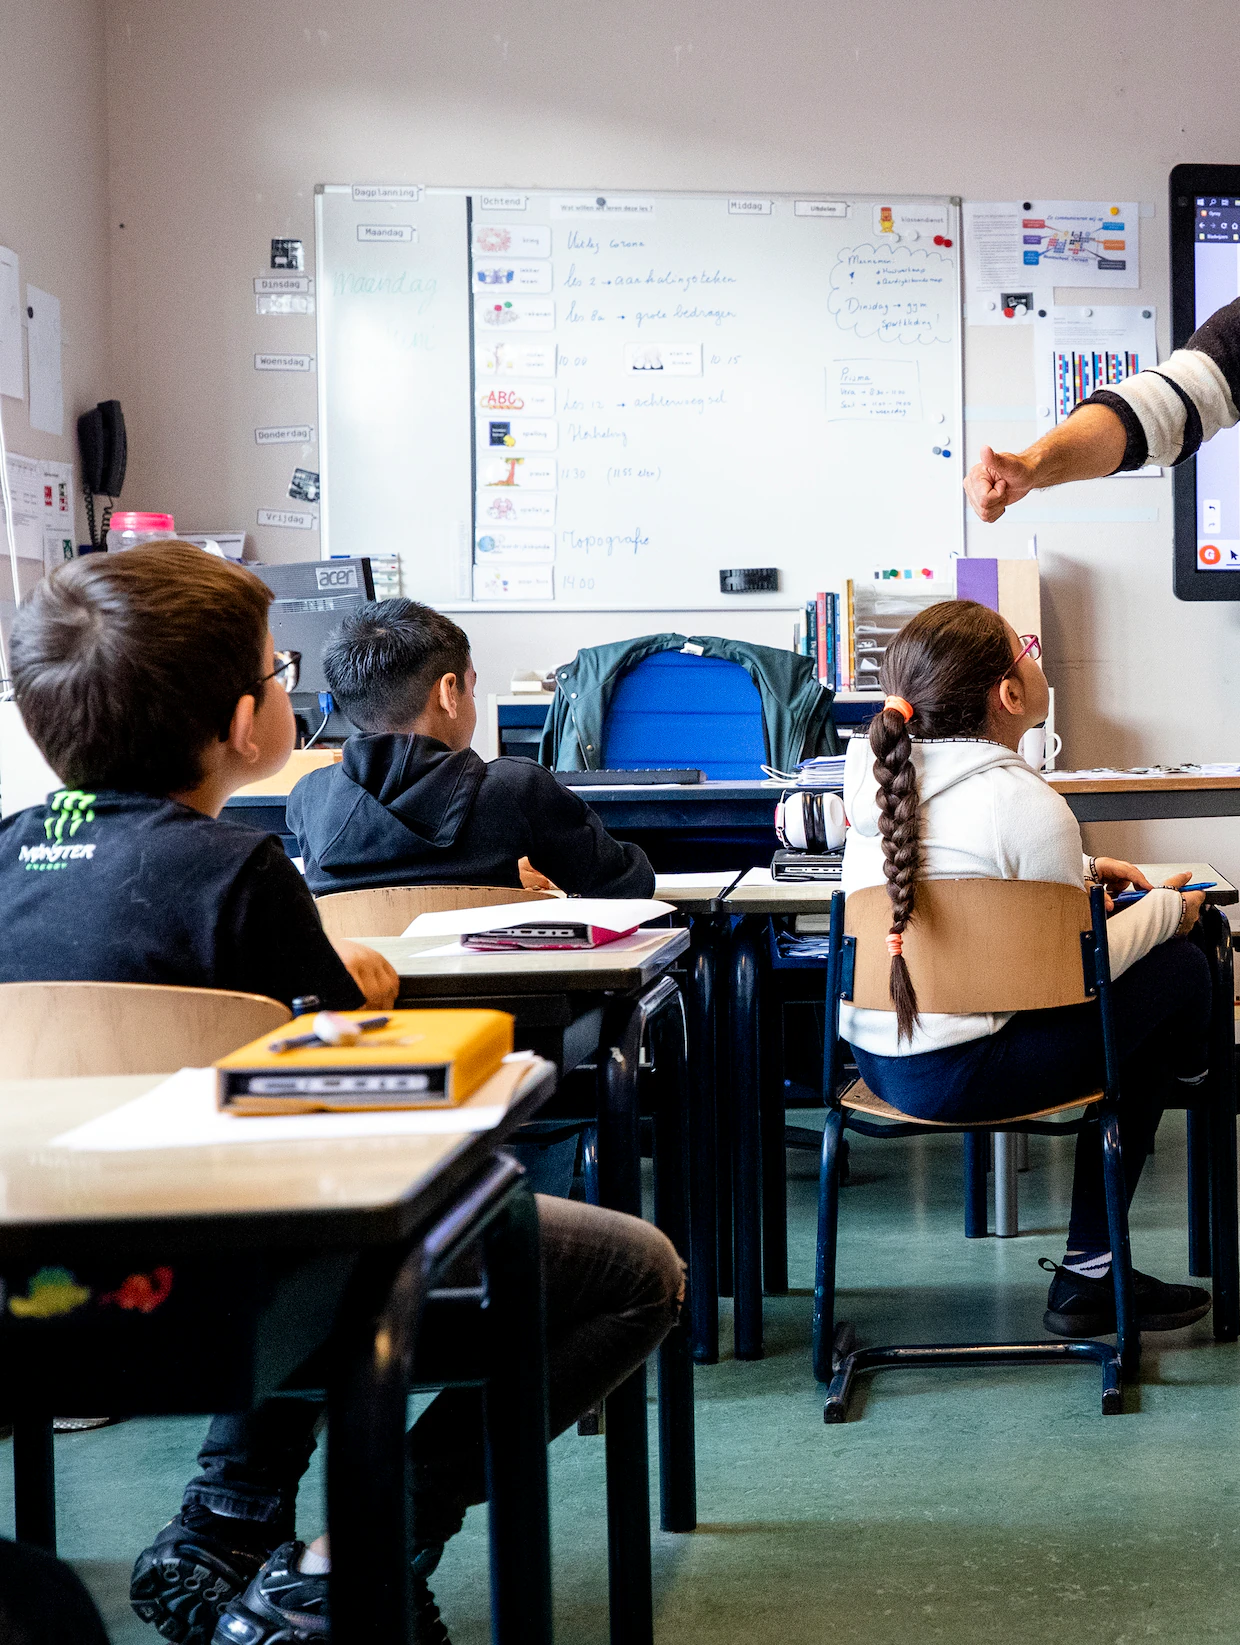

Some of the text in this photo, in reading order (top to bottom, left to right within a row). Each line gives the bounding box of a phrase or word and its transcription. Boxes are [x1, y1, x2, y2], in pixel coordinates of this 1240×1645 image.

[355, 187, 415, 199] Dagplanning
[483, 197, 521, 206] Ochtend
[730, 201, 763, 211] Middag
[901, 216, 944, 224] klassendienst
[365, 227, 404, 239] Maandag
[609, 239, 646, 249] corona
[262, 280, 300, 289] Dinsdag
[845, 297, 927, 315] Dinsdag gym
[260, 357, 304, 367] Woensdag
[487, 391, 516, 405] ABC
[258, 429, 307, 439] Donderdag
[266, 512, 304, 524] Vrijdag
[562, 526, 650, 557] Topografie
[319, 569, 355, 587] acer
[19, 843, 97, 862] MONSTER
